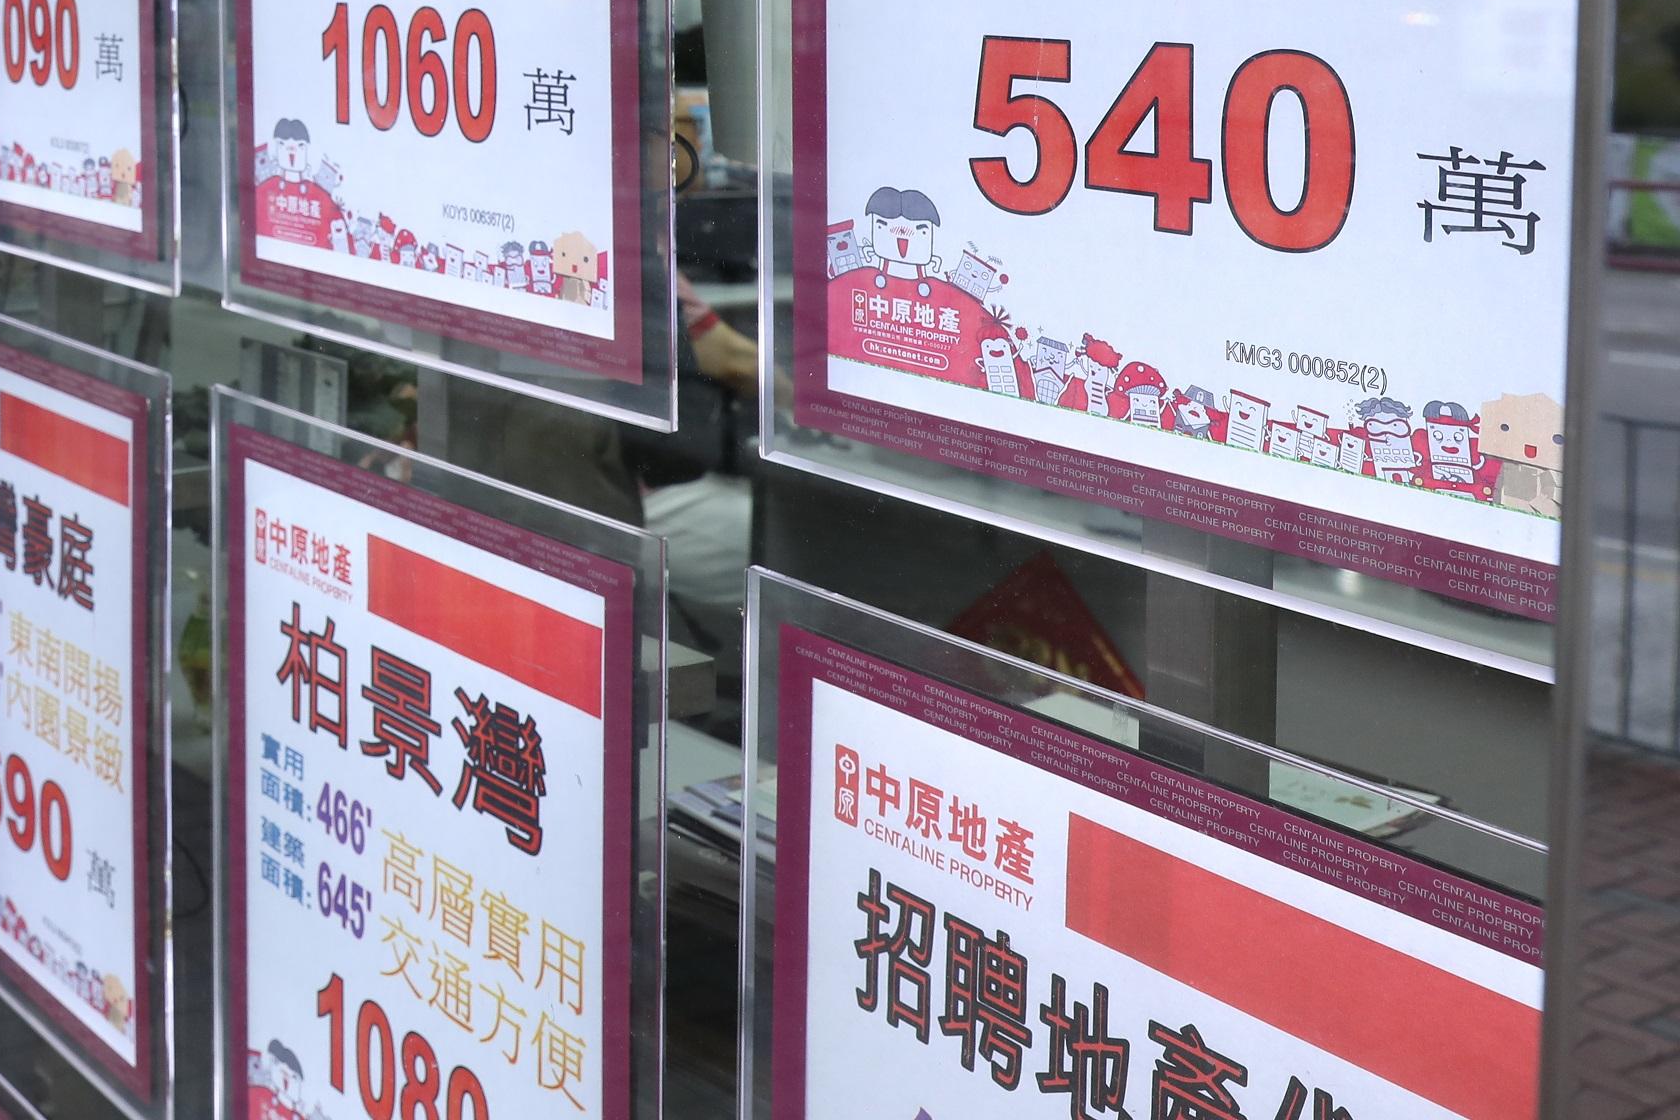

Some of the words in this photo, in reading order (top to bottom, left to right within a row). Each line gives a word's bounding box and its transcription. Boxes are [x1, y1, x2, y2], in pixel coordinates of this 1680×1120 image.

[94, 33, 124, 82] 萬
[321, 1, 497, 144] 1060
[523, 67, 577, 136] 萬
[969, 35, 1356, 254] 540
[1416, 145, 1547, 256] 萬
[869, 294, 961, 334] 中原地產
[869, 319, 914, 337] CENTALINE
[915, 329, 961, 345] PROPERTY
[869, 342, 941, 365] hk.centanet.com
[1225, 340, 1283, 370] KMG3
[1287, 352, 1388, 395] 000852(2)
[269, 516, 353, 586] 中原地產
[1131, 484, 1184, 505] CENTALINE
[1187, 497, 1238, 518] PROPERTY
[1264, 516, 1322, 541] CENTALINE
[1326, 531, 1384, 555] PROPERTY
[1413, 554, 1479, 580] CENTALINE
[1483, 571, 1549, 597] PROPERTY
[1165, 479, 1218, 499] CENTALINE
[1222, 492, 1275, 513] PROPERTY
[1298, 511, 1359, 534] CENTALINE
[1362, 527, 1422, 551] PROPERTY
[1448, 547, 1516, 574] CENTALINE
[1165, 506, 1218, 527] CENTALINE
[1222, 519, 1275, 541] PROPERTY
[1298, 539, 1359, 564] CENTALINE
[1362, 556, 1422, 580] PROPERTY
[1448, 578, 1516, 604] CENTALINE
[261, 731, 305, 781] 實用
[276, 601, 548, 857] 柏景灣
[261, 817, 305, 869] 建築
[863, 817, 945, 874] CENTALINE
[949, 856, 1034, 913] PROPERTY
[864, 762, 1036, 886] 中原地產
[1116, 769, 1168, 799] CENTALINE
[1171, 792, 1223, 821] PROPERTY
[1249, 821, 1308, 854] CENTALINE
[1310, 844, 1368, 877] PROPERTY
[1398, 876, 1464, 915] CENTALINE
[1468, 905, 1533, 943] PROPERTY
[1149, 796, 1204, 826] CENTALINE
[1206, 818, 1260, 849] PROPERTY
[1282, 848, 1342, 881] CENTALINE
[1346, 873, 1406, 906] PROPERTY
[1431, 905, 1499, 943] CENTALINE
[1150, 769, 1204, 799] CENTALINE
[1206, 791, 1260, 822] PROPERTY
[1283, 818, 1343, 853] CENTALINE
[1346, 843, 1406, 877] PROPERTY
[1432, 876, 1500, 913] CENTALINE
[316, 781, 372, 856] 466'
[380, 823, 586, 1017] 高層實用
[319, 861, 372, 940] 645'
[379, 912, 586, 1112] 交通方便
[855, 866, 1356, 1120] 招聘地產
